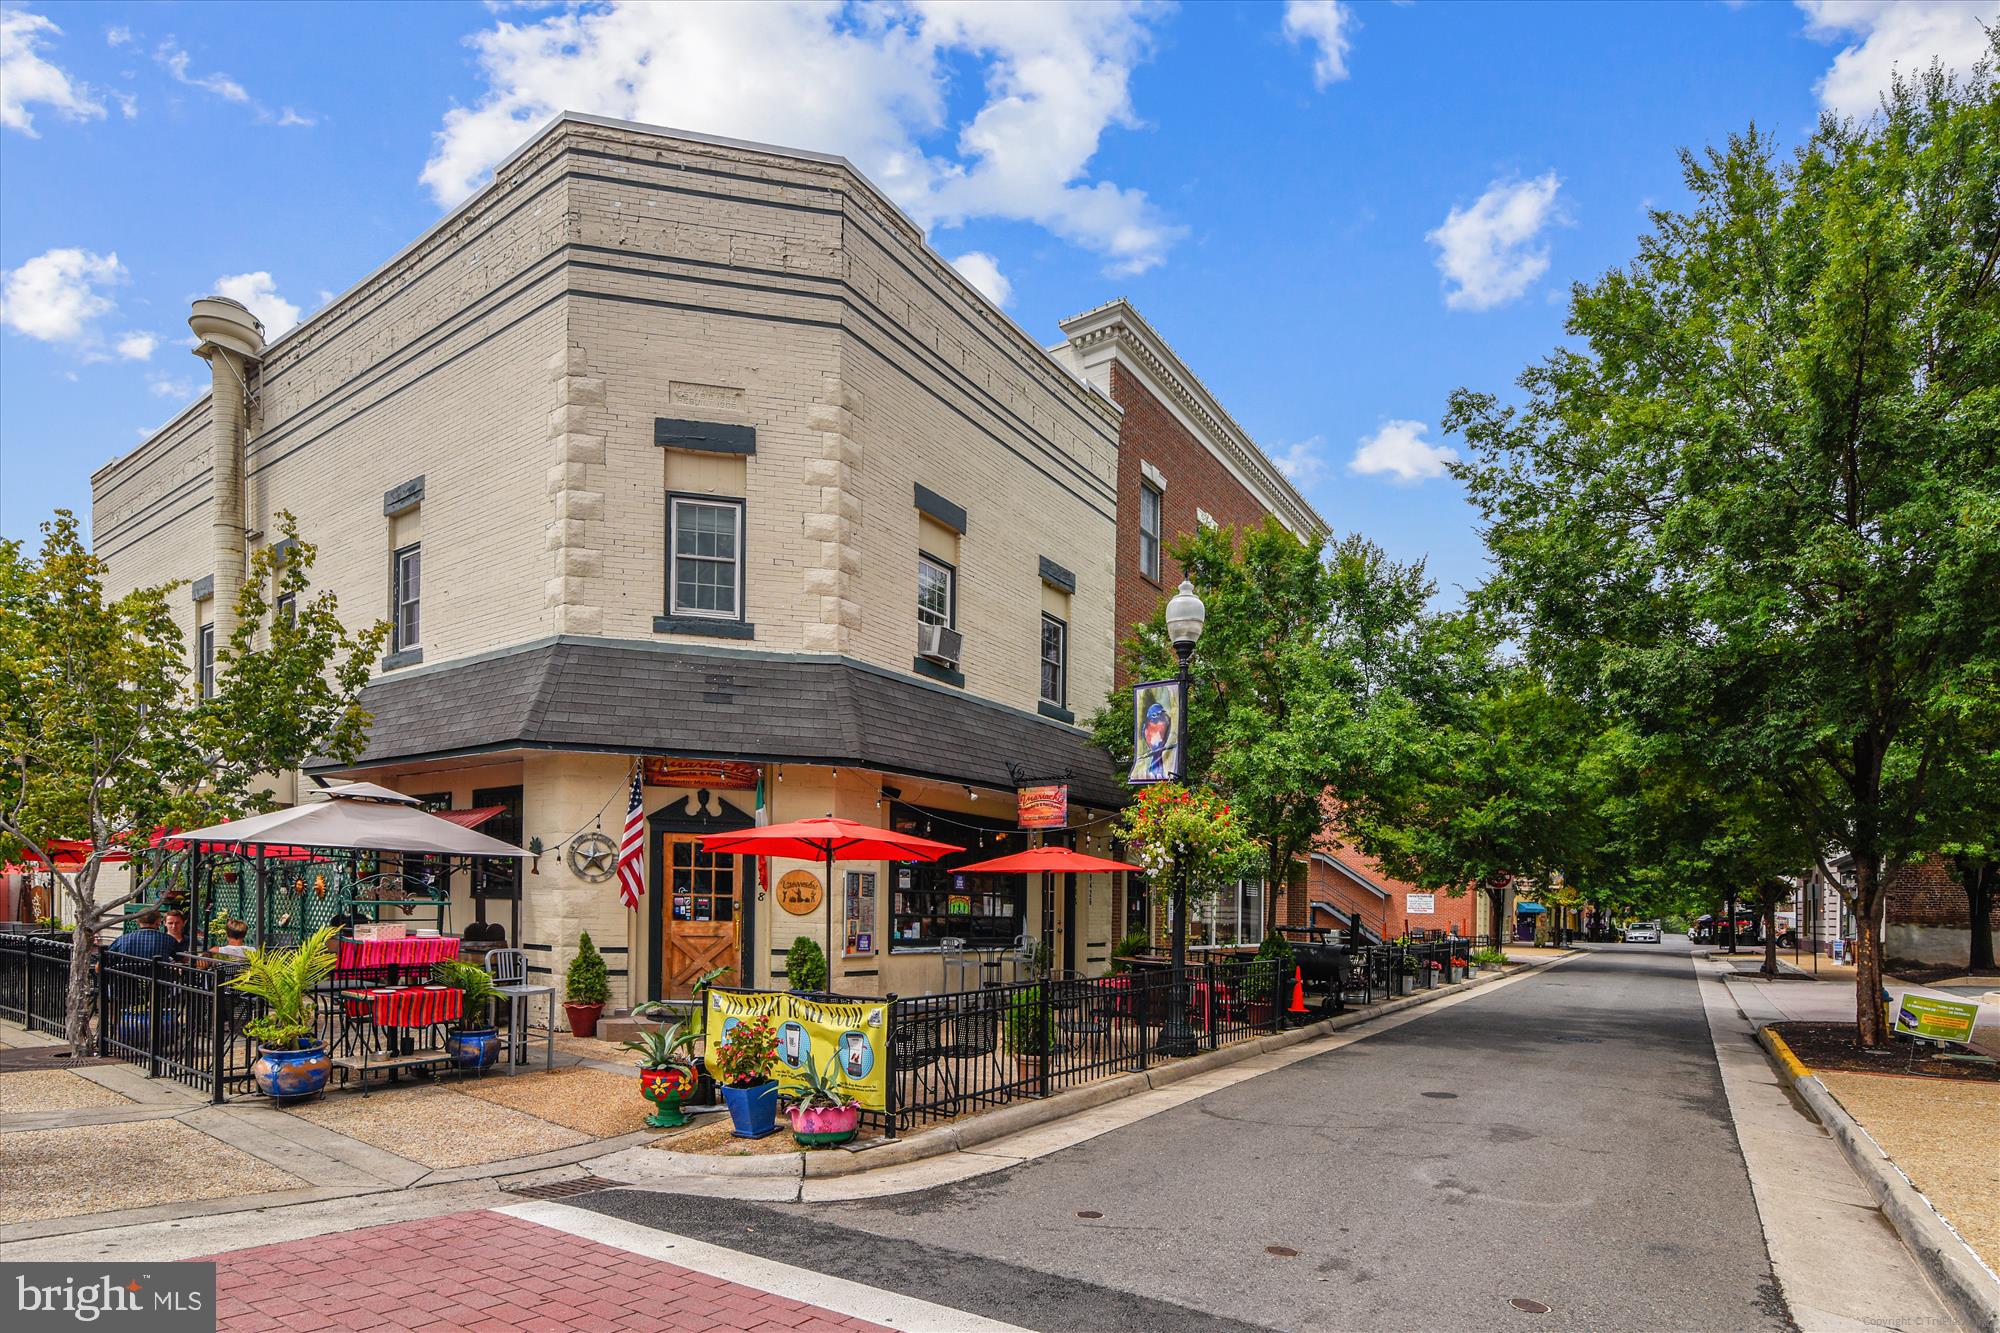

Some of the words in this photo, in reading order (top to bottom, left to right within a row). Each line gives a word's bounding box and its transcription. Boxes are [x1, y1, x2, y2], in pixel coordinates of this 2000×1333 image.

[745, 995, 782, 1017] GREAT
[787, 996, 800, 1019] TO
[804, 1001, 824, 1024] SEE
[825, 1006, 863, 1029] YOU!!
